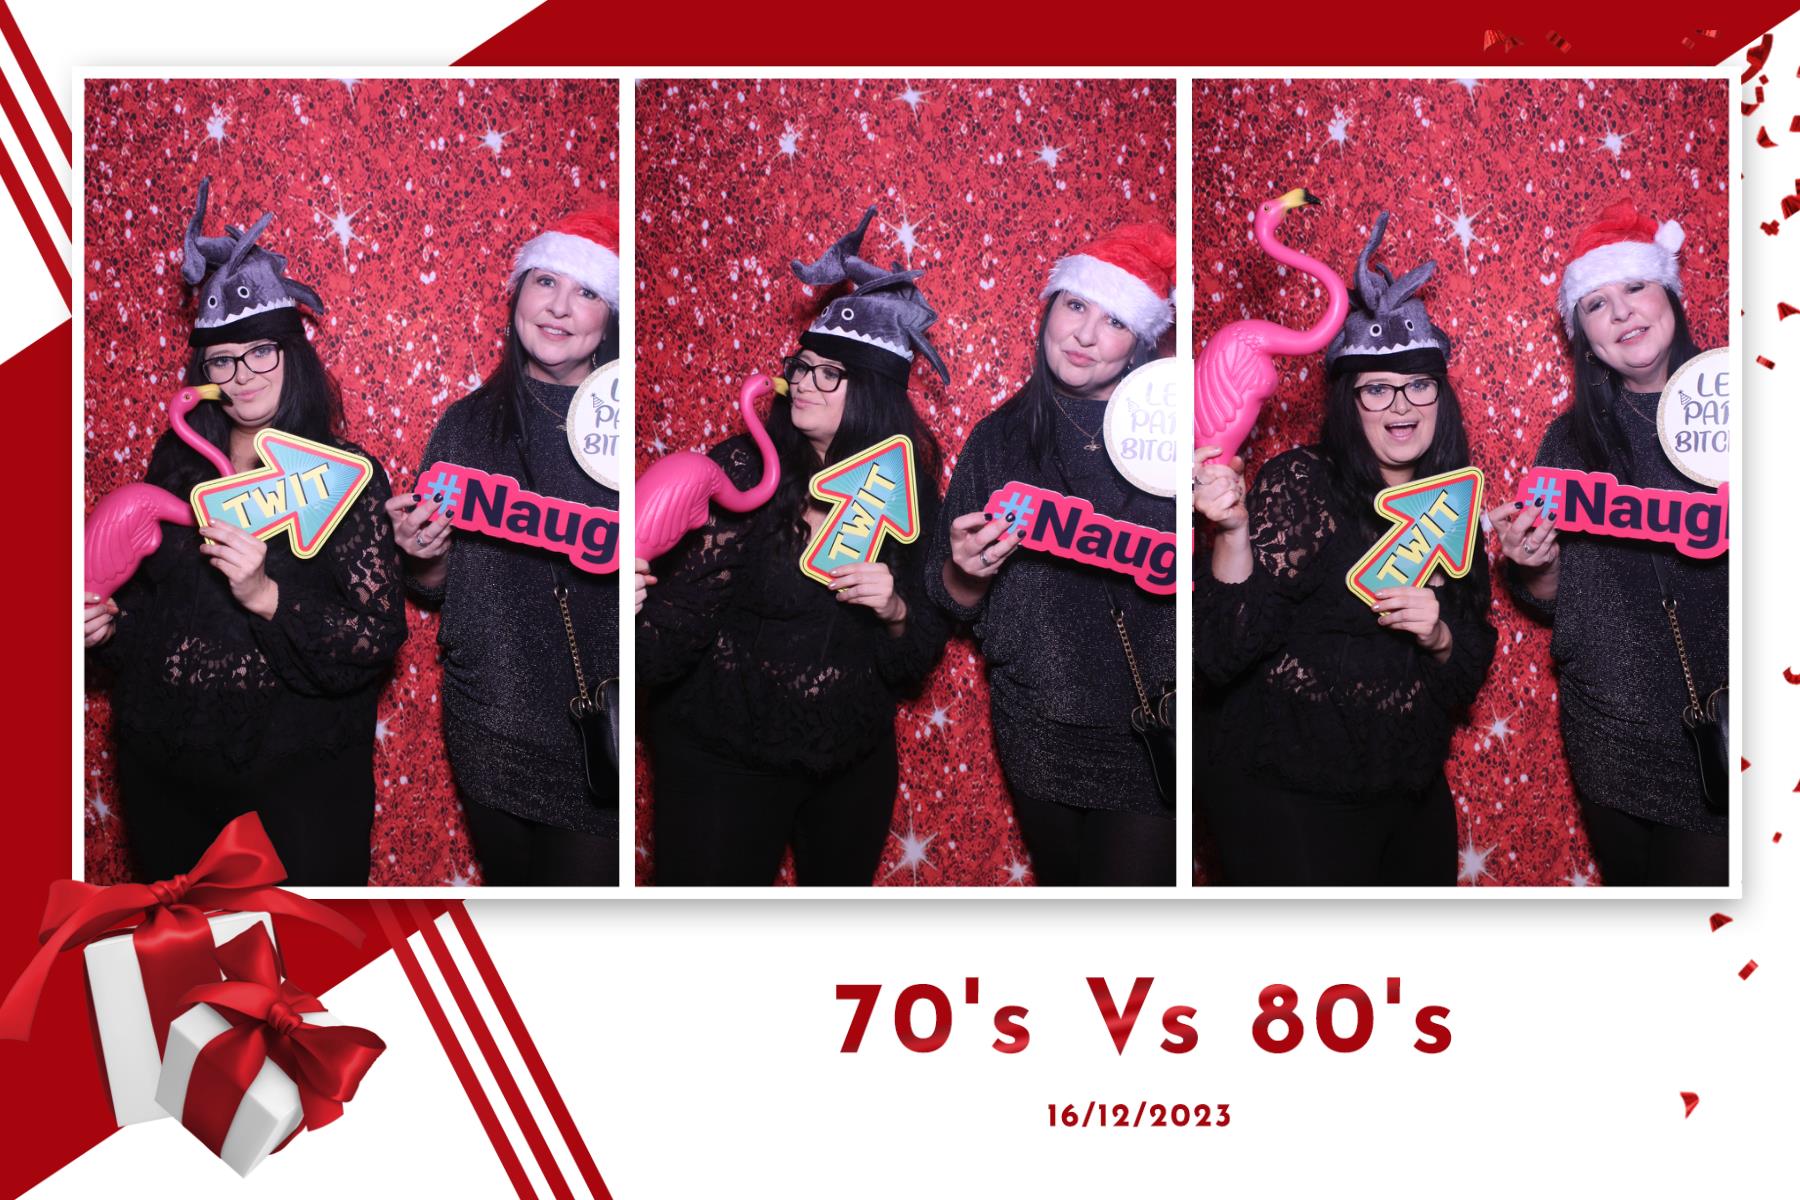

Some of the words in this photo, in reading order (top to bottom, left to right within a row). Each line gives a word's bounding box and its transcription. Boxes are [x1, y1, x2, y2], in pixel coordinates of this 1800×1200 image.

[1675, 430, 1729, 453] BITC
[222, 461, 331, 530] TWIT
[827, 461, 897, 561] TWIT
[1525, 476, 1729, 550] #Naug
[1376, 488, 1460, 585] TWIT
